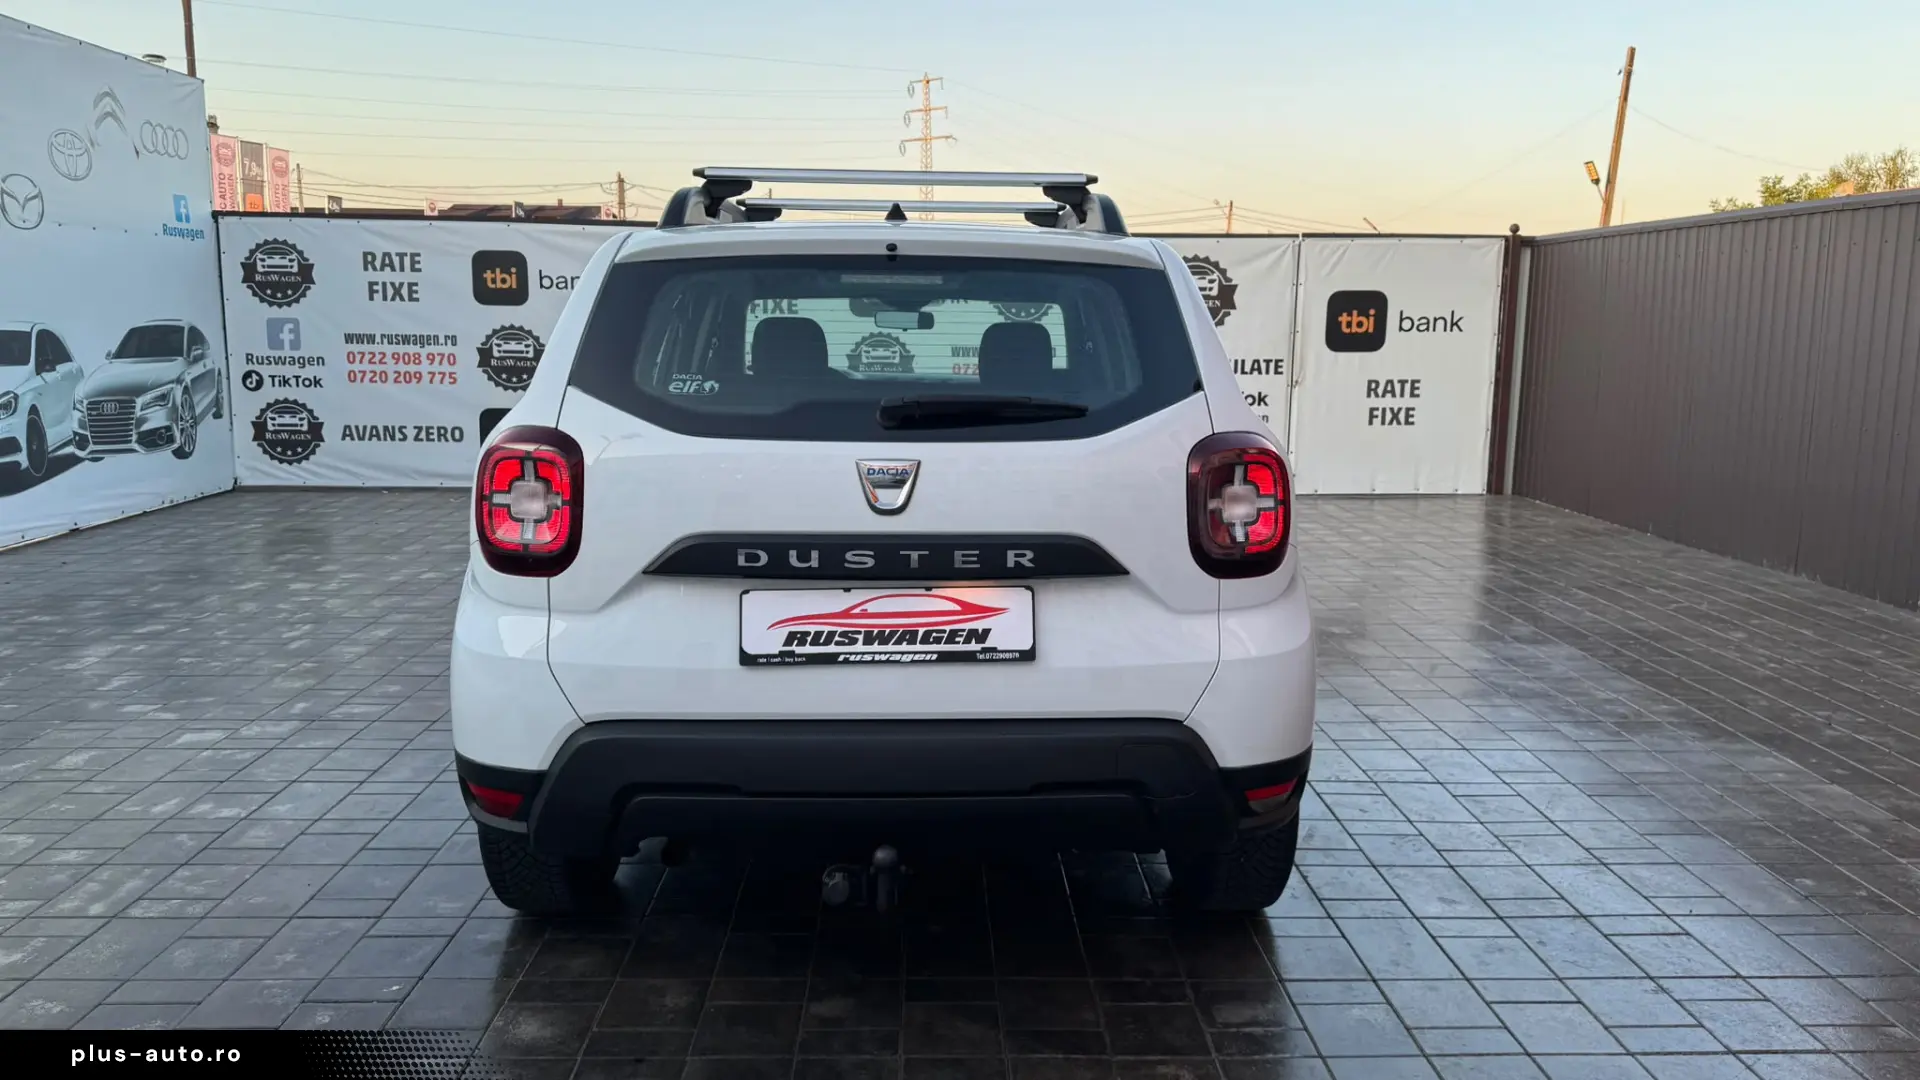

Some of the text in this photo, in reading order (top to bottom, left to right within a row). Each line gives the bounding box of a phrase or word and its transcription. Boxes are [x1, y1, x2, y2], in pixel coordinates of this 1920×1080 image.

[162, 223, 205, 241] Ruswagen
[362, 251, 423, 273] RATE
[483, 267, 518, 289] tbi
[367, 281, 421, 302] FIXE
[751, 299, 799, 315] FIXE
[1338, 308, 1464, 335] tbi bank
[344, 332, 458, 348] www.ruswagen.ro
[245, 353, 326, 369] Ruswagen
[346, 351, 457, 367] 0722 908 970
[347, 370, 458, 385] 0720 209 775
[672, 373, 703, 381] DACIA
[952, 363, 980, 376] 072
[268, 374, 324, 389] TikTok
[668, 380, 702, 393] elf
[1366, 378, 1421, 399] RATE
[1367, 406, 1416, 426] FIXE
[341, 424, 464, 443] AVANS ZERO
[867, 467, 910, 477] DACIA
[736, 548, 1036, 569] DUSTER
[781, 627, 992, 648] RUSWAGEN
[837, 653, 938, 663] ruswagen
